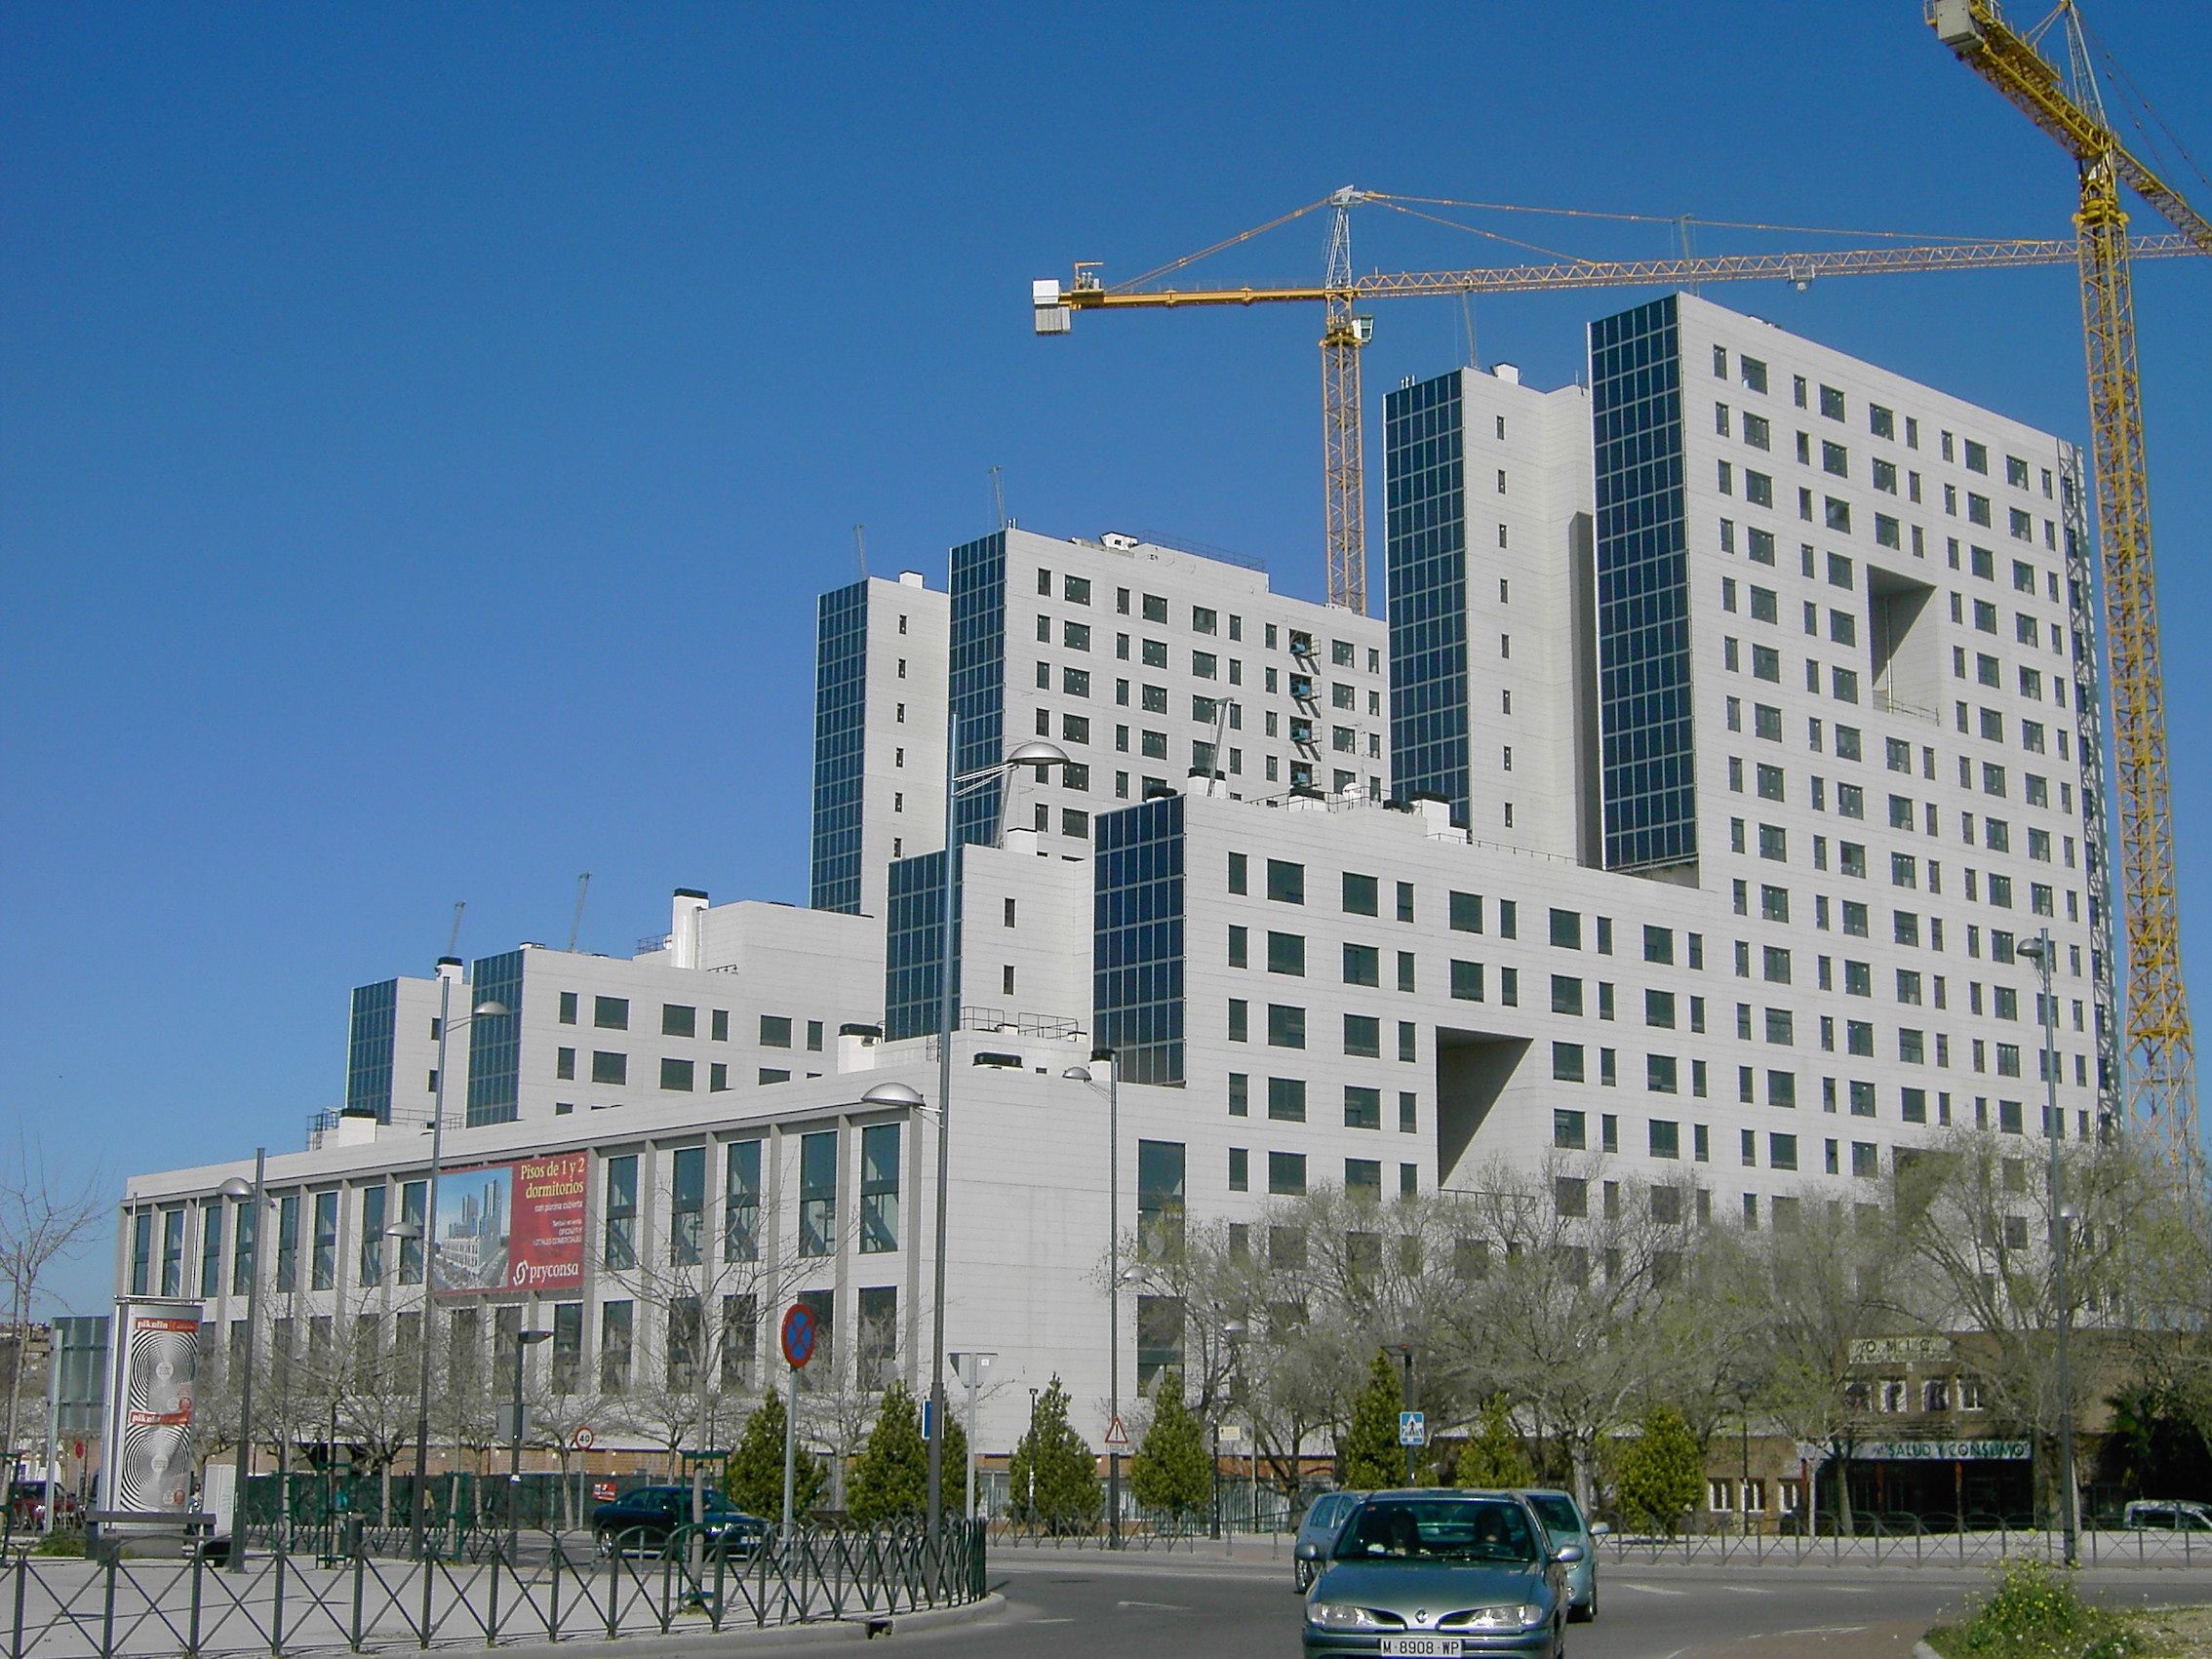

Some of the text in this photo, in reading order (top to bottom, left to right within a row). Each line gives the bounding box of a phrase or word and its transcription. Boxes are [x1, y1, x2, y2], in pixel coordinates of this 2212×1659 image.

[521, 1158, 585, 1180] Pisos de 1 y 2
[526, 1179, 584, 1199] dormitorios
[530, 1262, 578, 1283] pryconsa
[1936, 1443, 1945, 1456] Y
